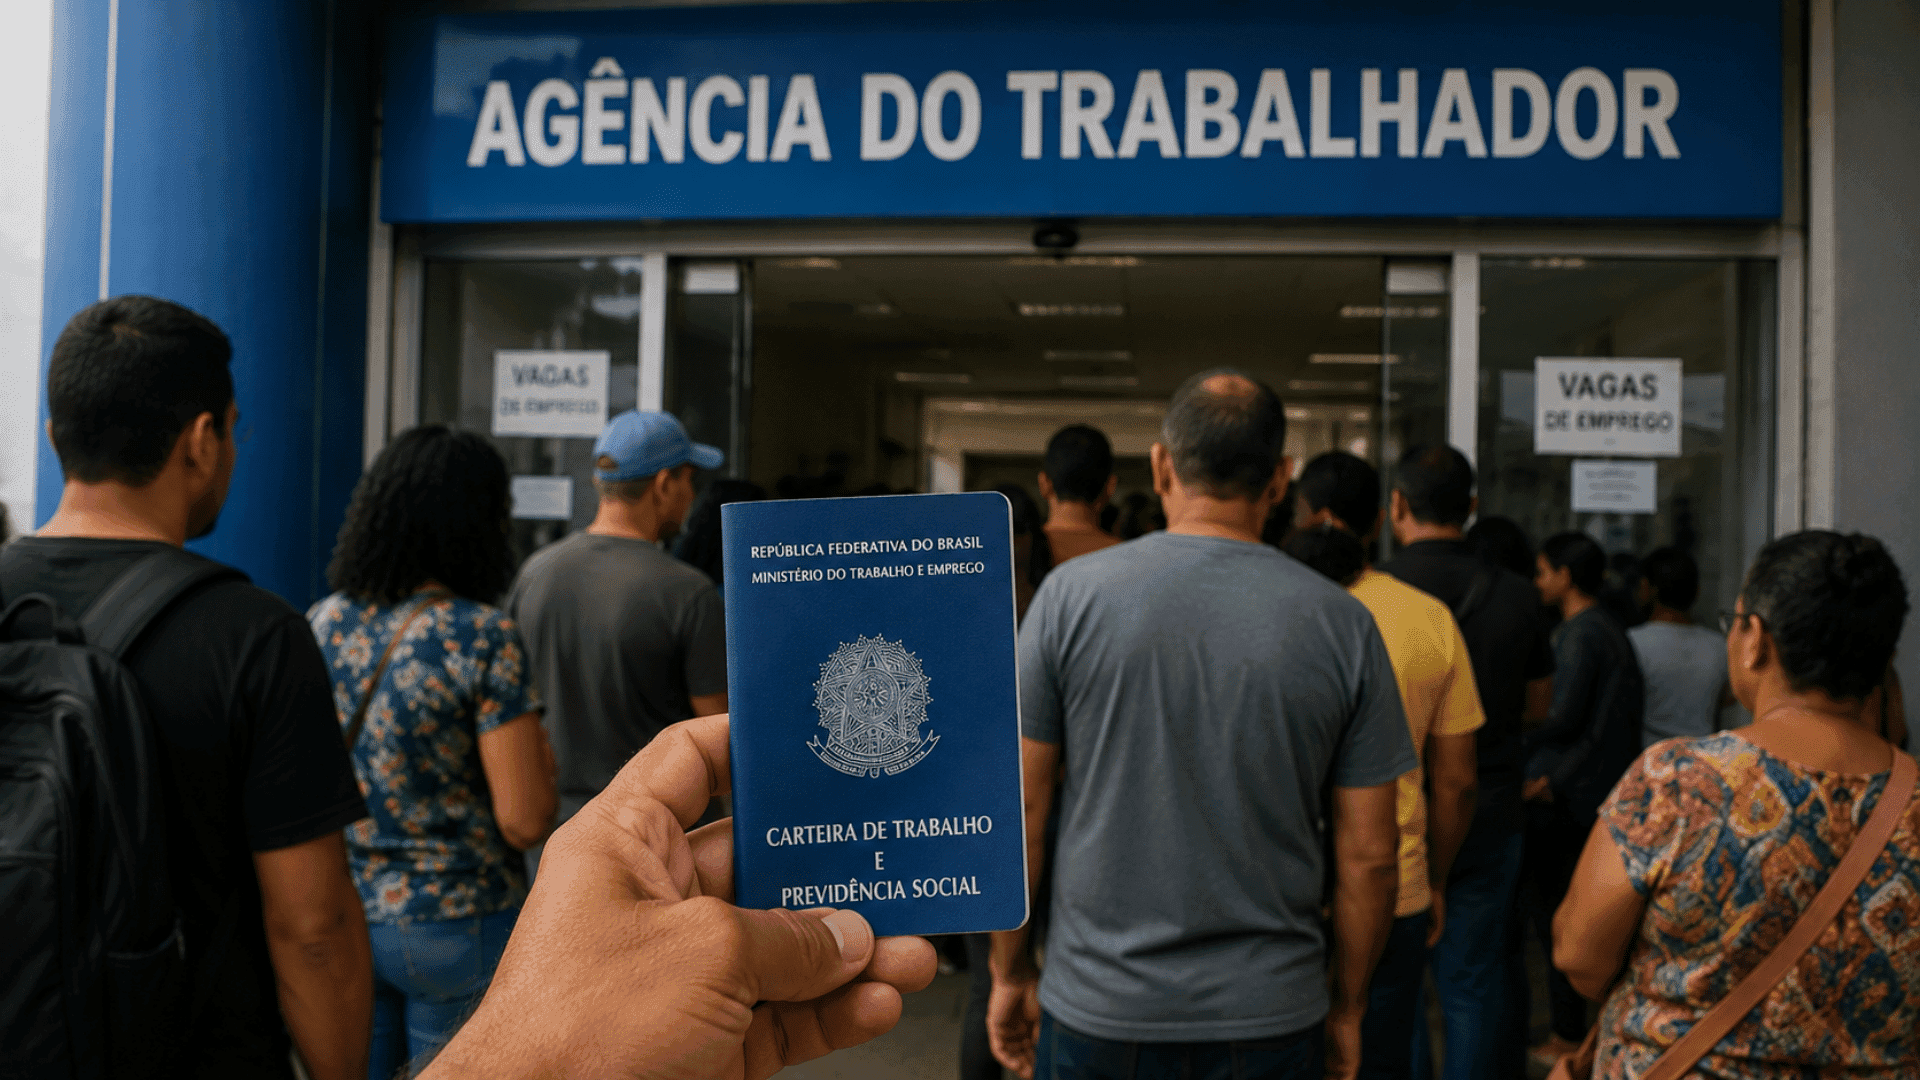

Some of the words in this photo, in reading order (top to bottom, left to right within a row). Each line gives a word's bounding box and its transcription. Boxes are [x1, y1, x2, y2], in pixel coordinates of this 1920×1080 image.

[468, 59, 832, 167] AGÊNCIA
[860, 72, 981, 161] DO
[1007, 68, 1680, 159] TRABALHADOR
[1558, 371, 1658, 400] VAGAS
[1545, 411, 1571, 431] DE
[751, 542, 824, 558] REPÚBLICA
[828, 539, 907, 554] FEDERATIVA
[911, 538, 934, 551] DO
[938, 536, 984, 550] BRASIL
[752, 567, 823, 583] MINISTÉRIO
[827, 567, 846, 581] DO
[850, 565, 914, 580] TRABALHO
[918, 564, 925, 576] E
[928, 562, 985, 576] EMPREGO
[766, 825, 857, 847] CARTEIRA
[863, 820, 888, 840] DE
[892, 816, 993, 838] TRABALHO
[875, 852, 884, 871] E
[782, 878, 906, 907] PREVIDÊNCIA
[912, 876, 981, 898] SOCIAL
